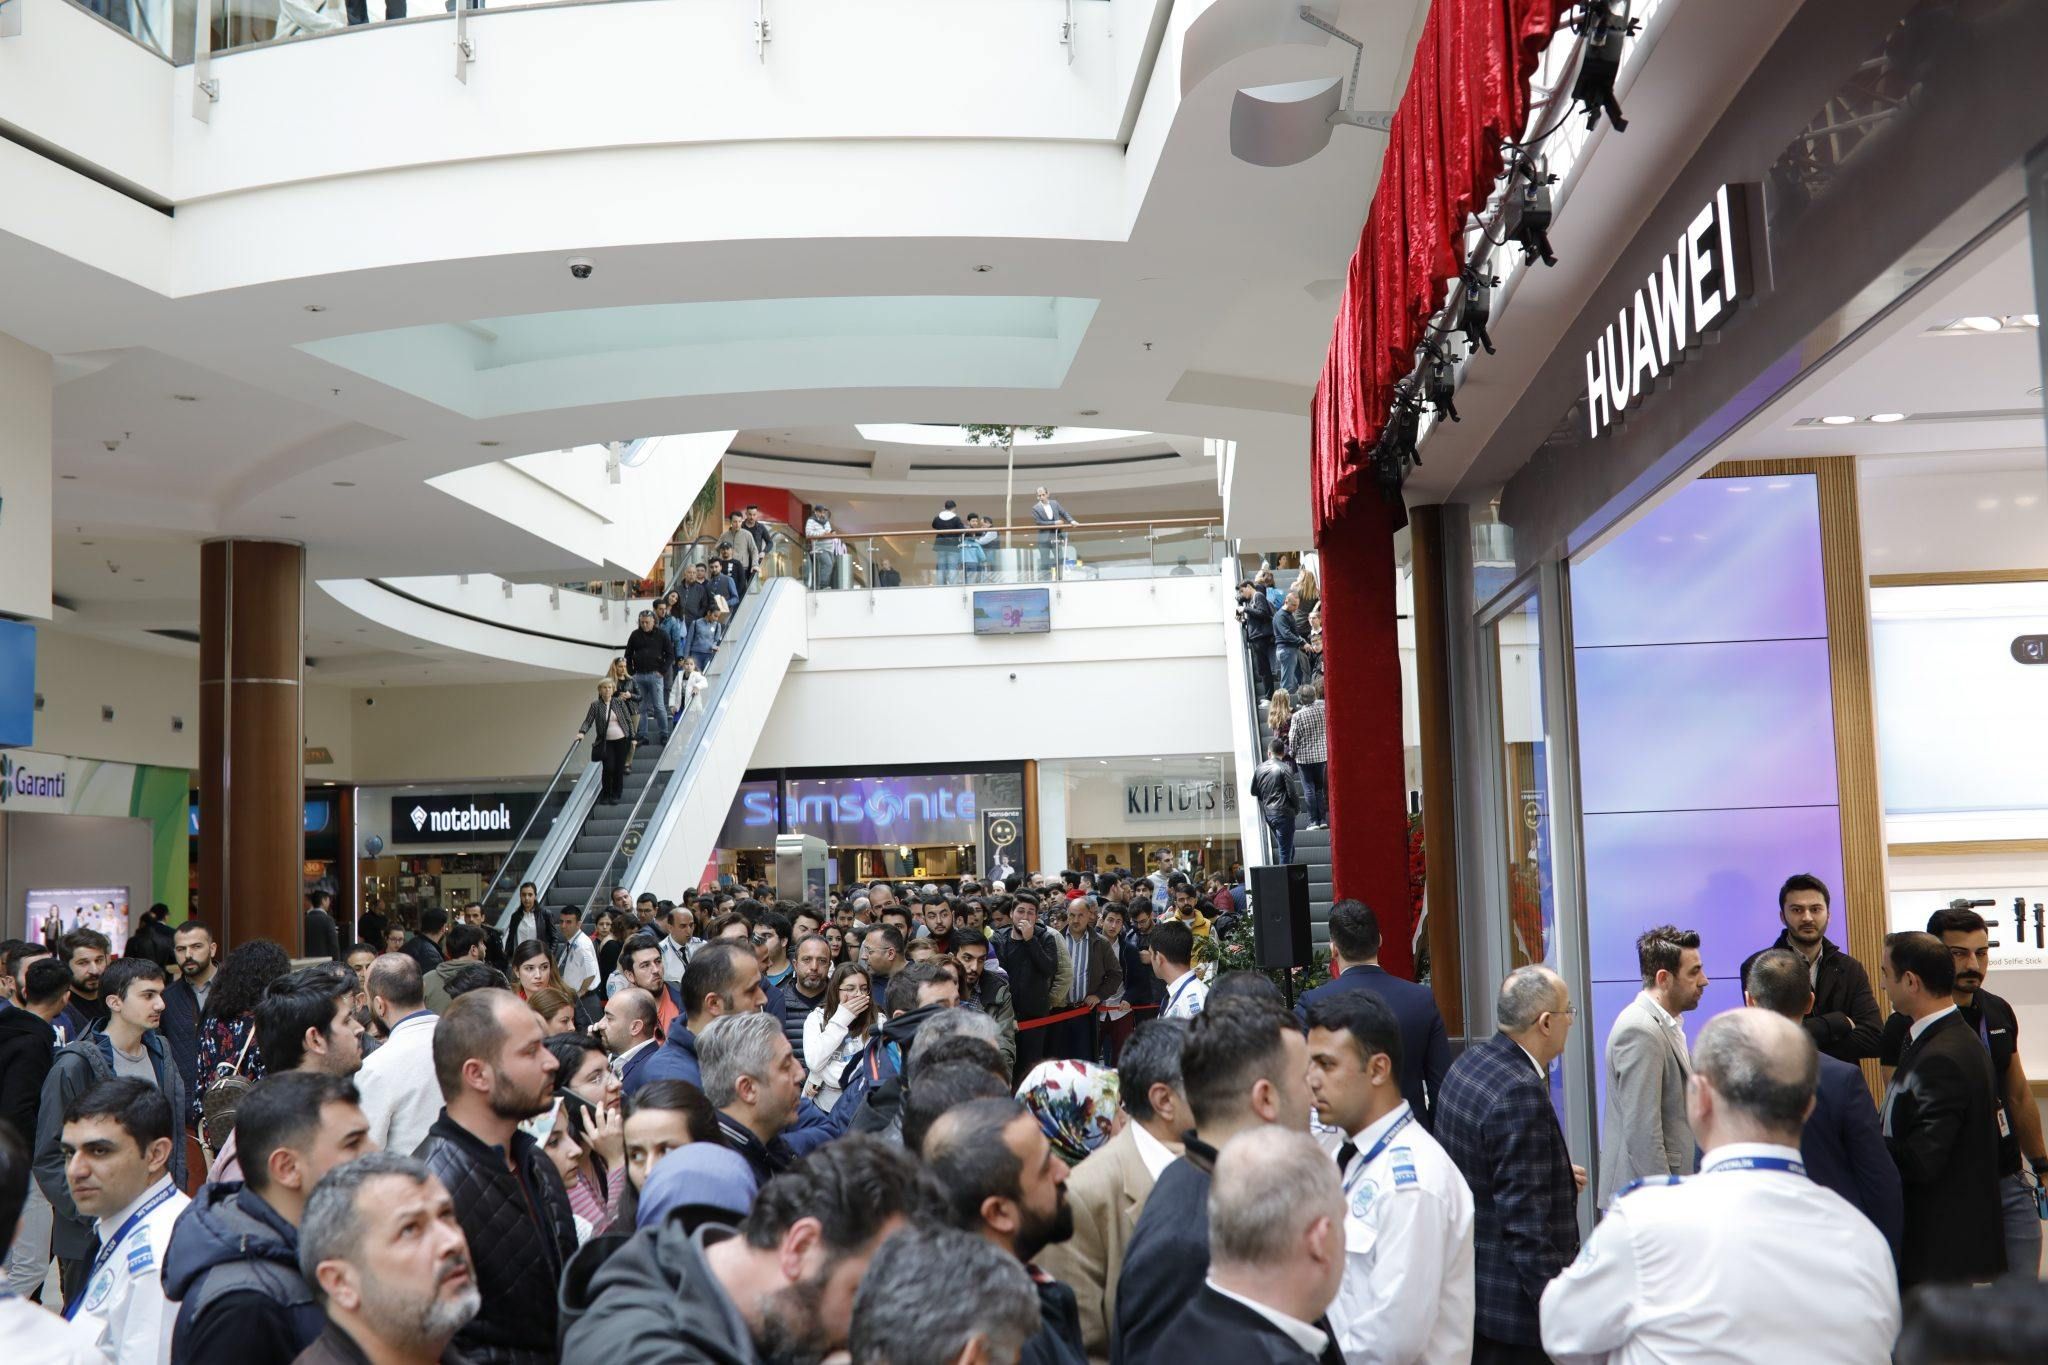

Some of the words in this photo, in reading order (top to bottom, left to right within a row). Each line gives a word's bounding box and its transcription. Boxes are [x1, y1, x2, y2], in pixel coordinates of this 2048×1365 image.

[1586, 183, 1737, 439] HUAWEI
[16, 766, 65, 798] Garanti
[1127, 782, 1215, 814] KIFIDIS
[430, 803, 511, 832] notebook
[743, 787, 976, 827] Samsonite
[2025, 956, 2042, 965] Stick
